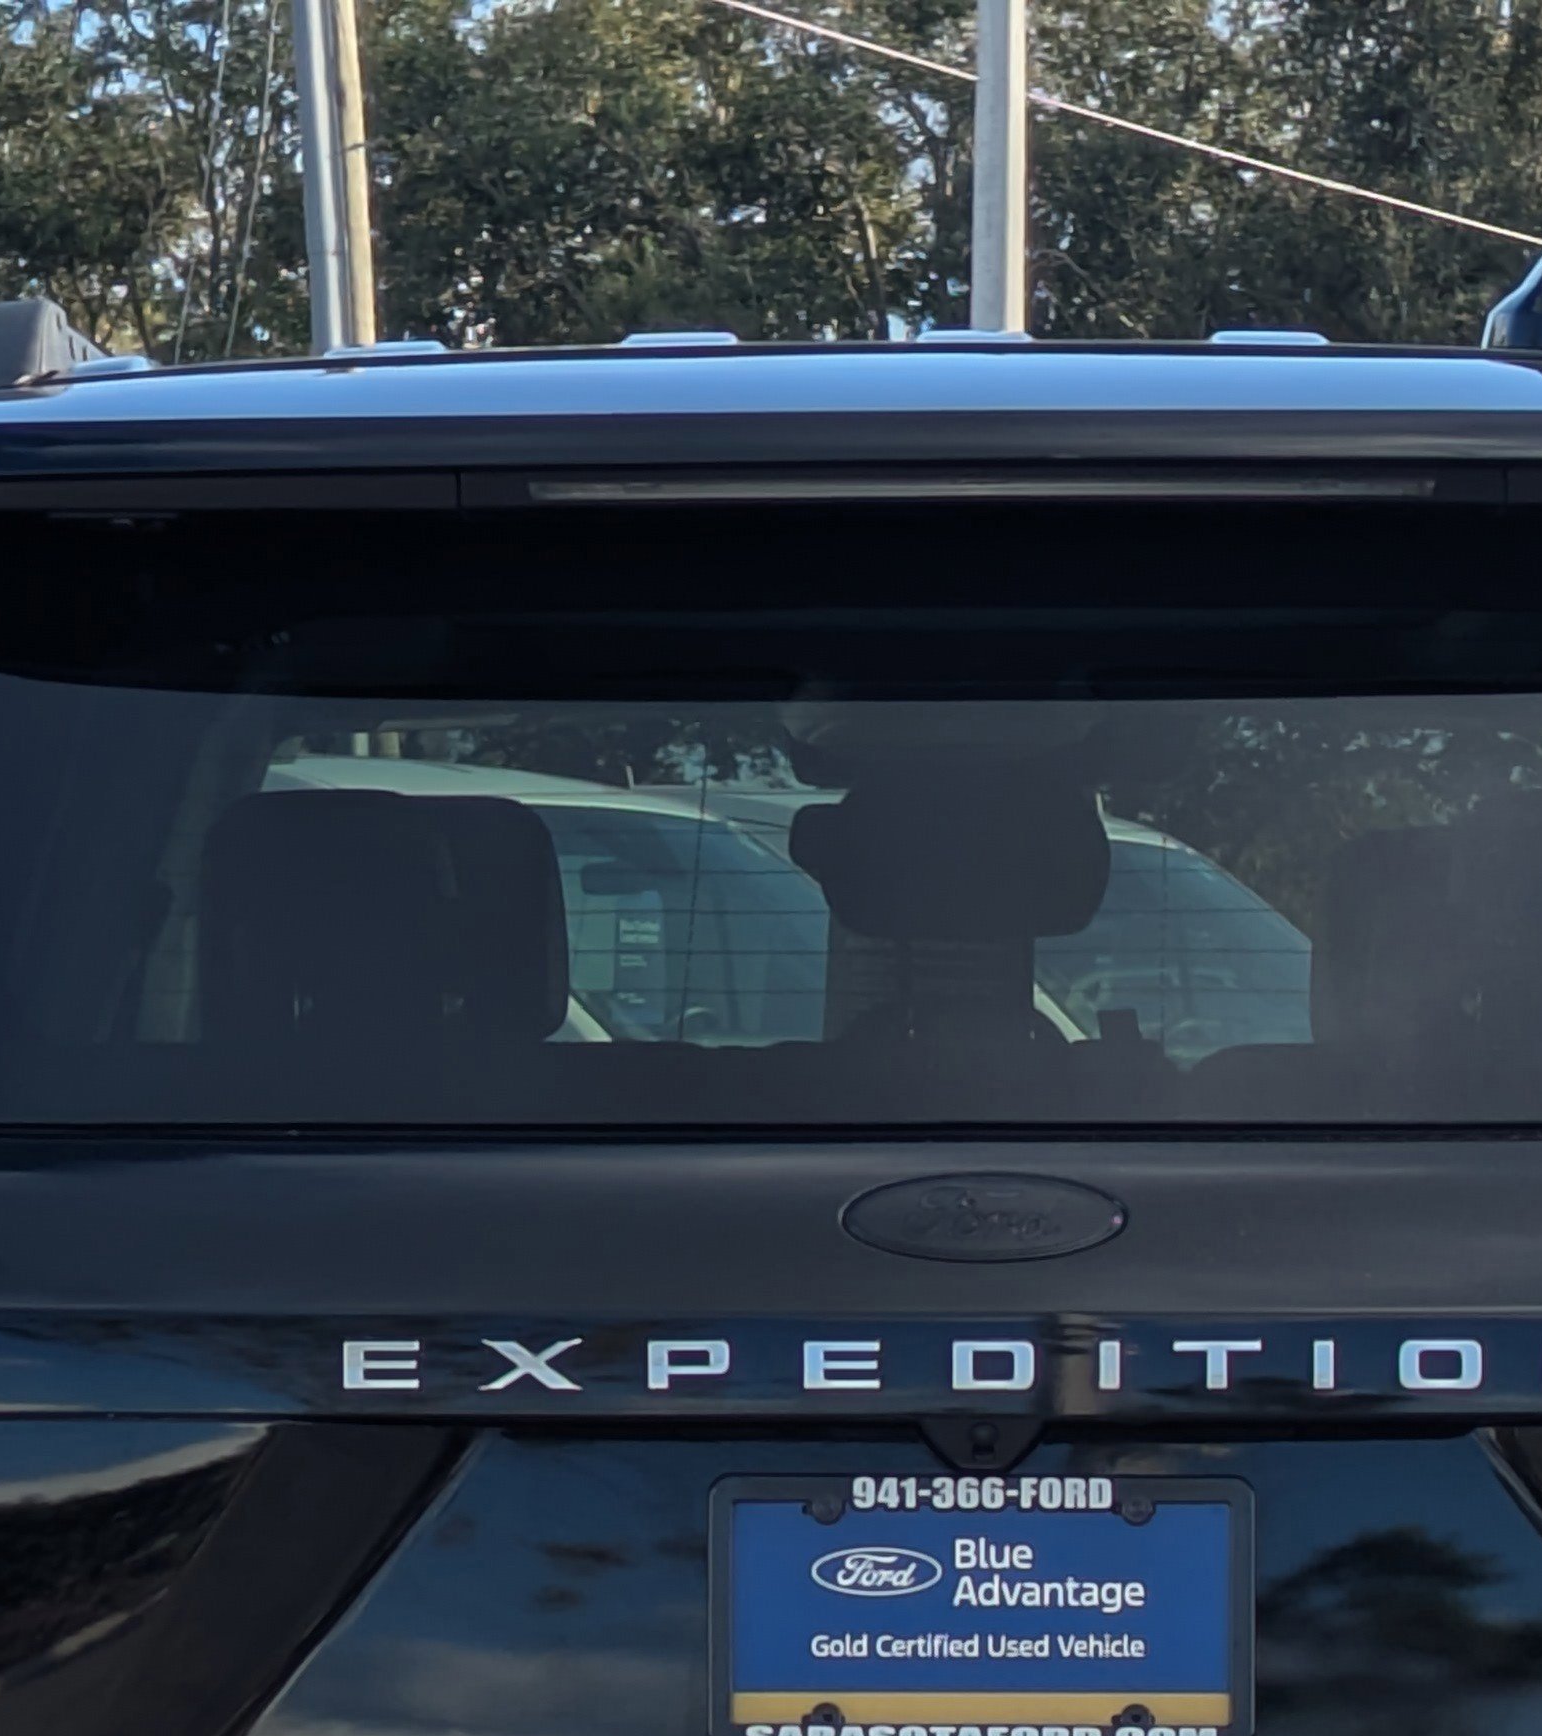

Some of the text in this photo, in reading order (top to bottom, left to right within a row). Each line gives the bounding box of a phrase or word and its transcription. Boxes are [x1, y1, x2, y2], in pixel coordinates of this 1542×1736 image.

[852, 1476, 1113, 1510] 941-366-FORD
[836, 1553, 917, 1587] Ford
[954, 1537, 1033, 1570] Blue
[952, 1574, 1145, 1613] Advantage
[810, 1633, 1146, 1658] Gold Certified Used Vehicle
